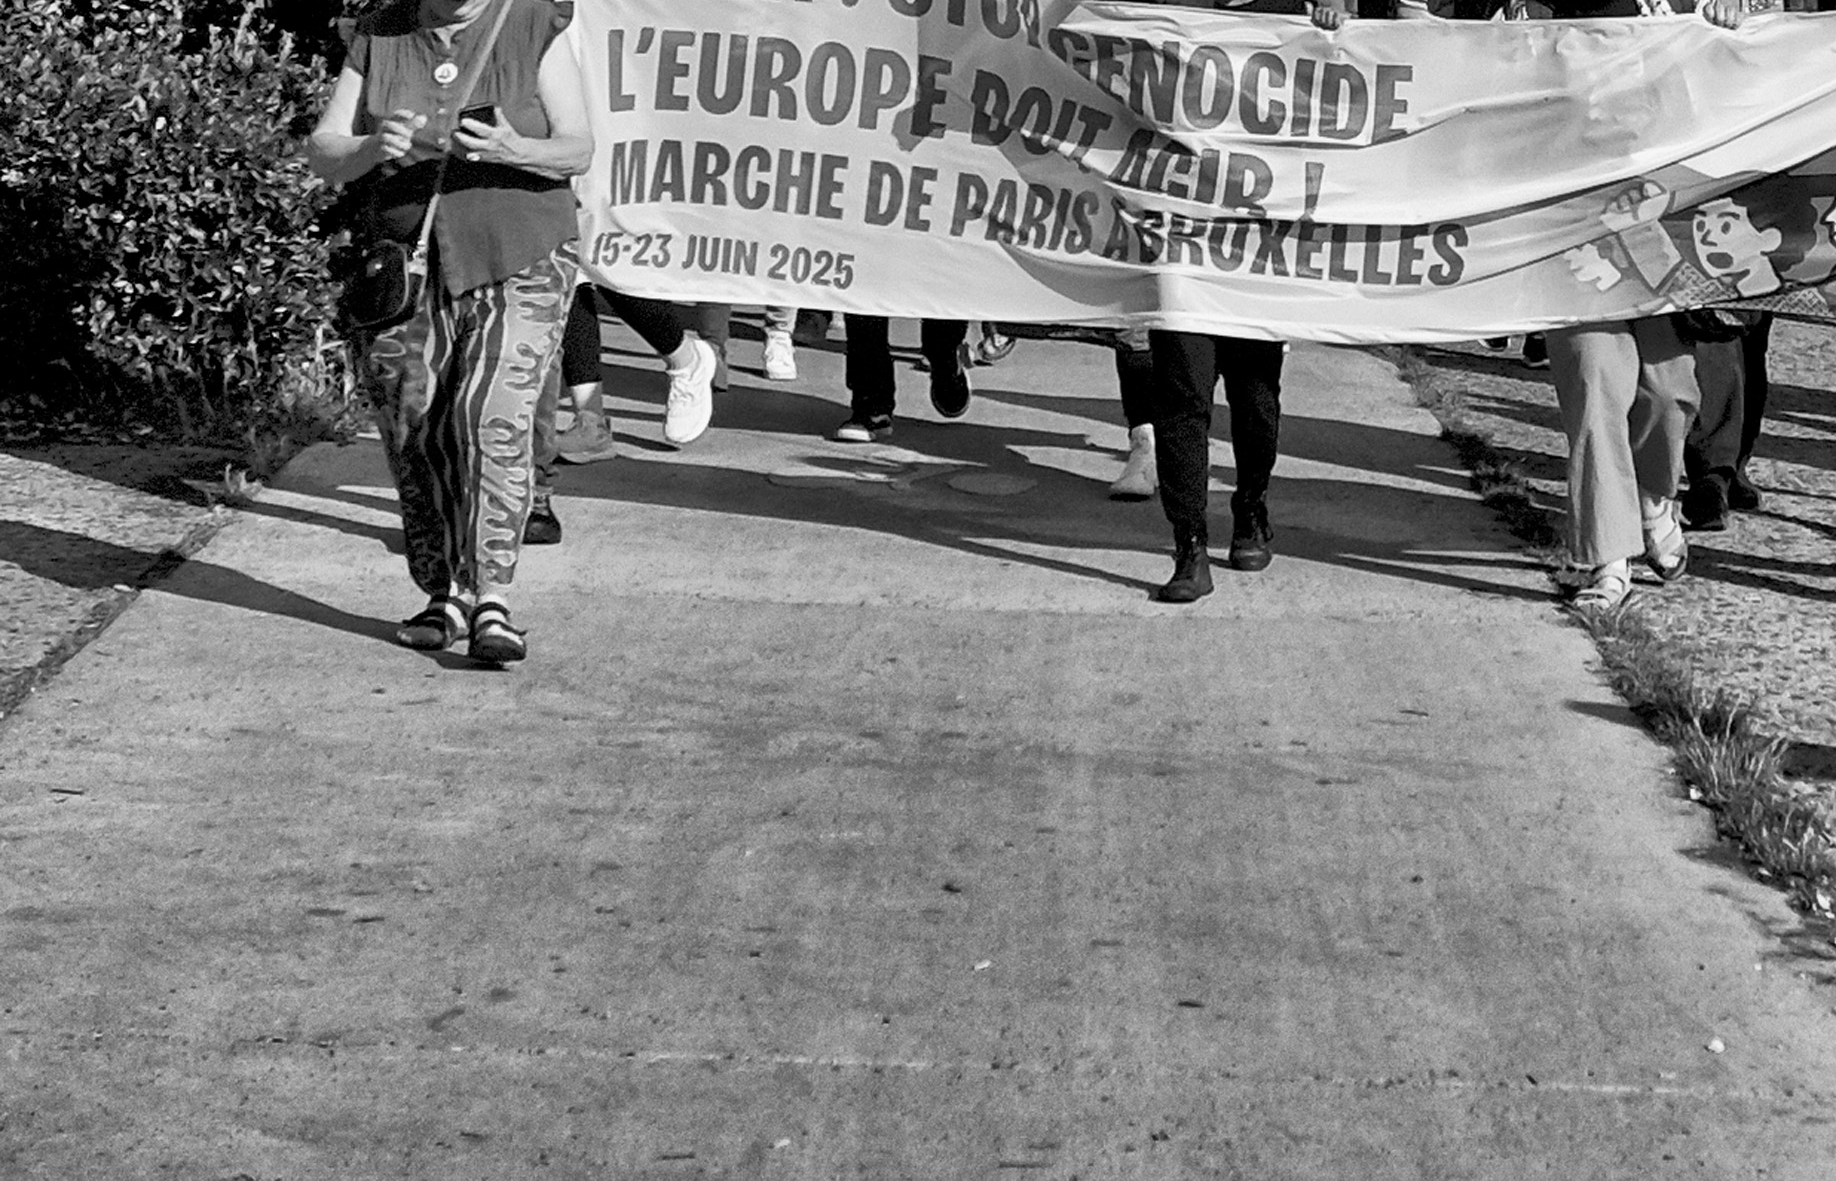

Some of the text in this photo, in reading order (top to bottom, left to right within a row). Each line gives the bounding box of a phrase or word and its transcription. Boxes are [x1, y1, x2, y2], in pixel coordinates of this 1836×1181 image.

[607, 26, 952, 138] L'EUROPE
[971, 69, 1114, 174] DOIT
[1048, 27, 1413, 144] GENOCIDE
[591, 232, 855, 290] 15-23 JUIN 2025
[609, 139, 849, 220] MARCHE
[864, 161, 938, 232] DE
[949, 172, 1100, 254] PARIS
[1133, 210, 1469, 286] BRUXELLES
